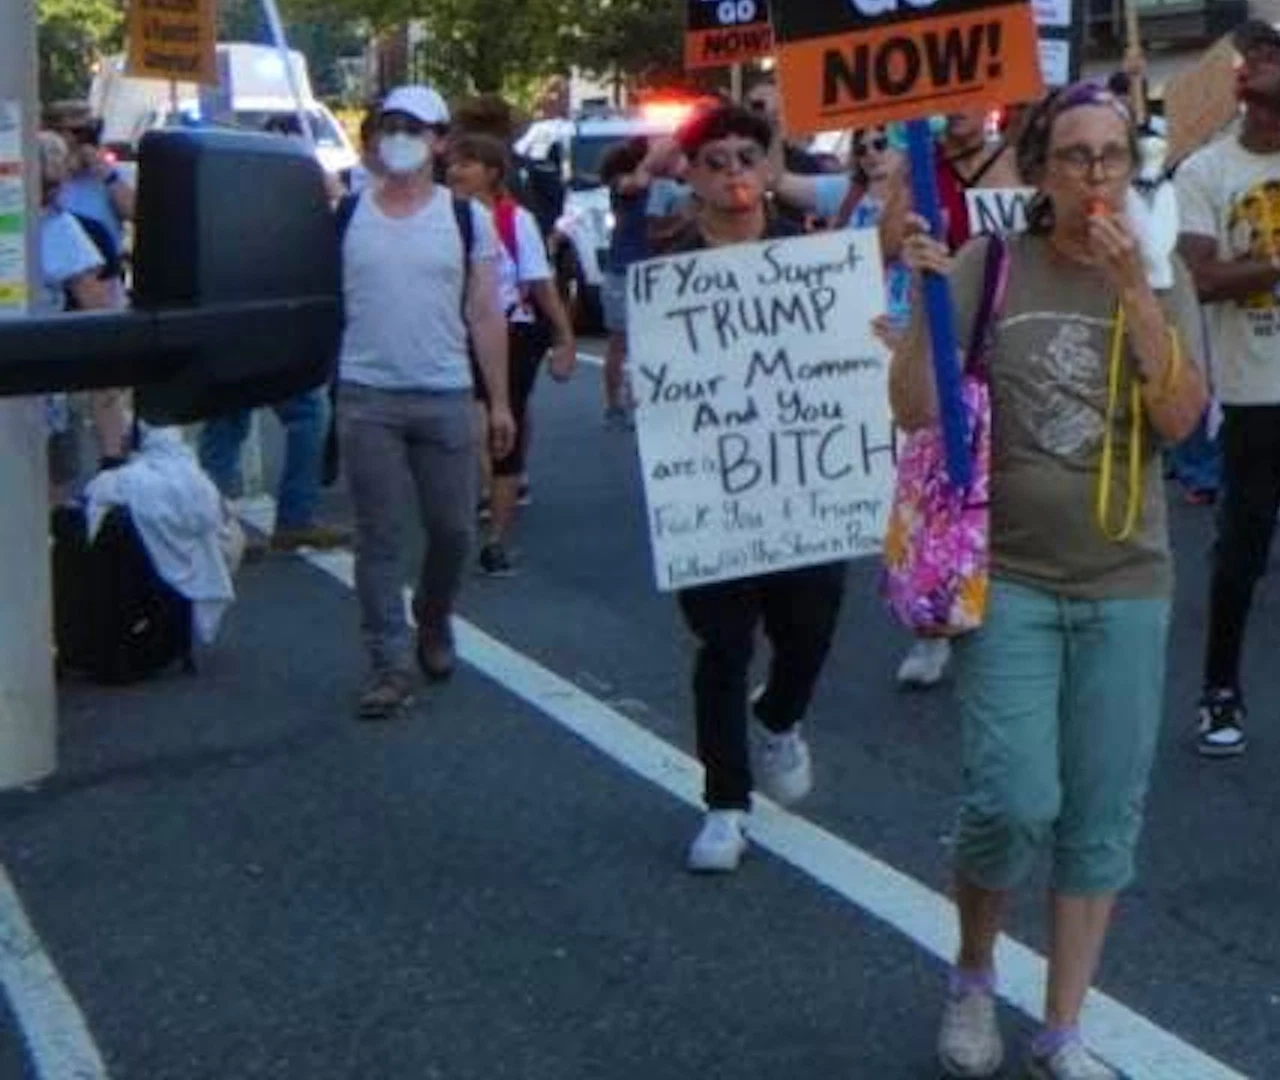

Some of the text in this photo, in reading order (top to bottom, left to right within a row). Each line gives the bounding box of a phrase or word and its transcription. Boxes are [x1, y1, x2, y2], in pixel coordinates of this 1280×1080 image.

[821, 21, 1003, 106] NOW!
[670, 257, 741, 299] You
[664, 286, 837, 356] TRUMP
[638, 361, 730, 406] Your
[692, 390, 843, 434] And You
[717, 422, 899, 496] BITCH
